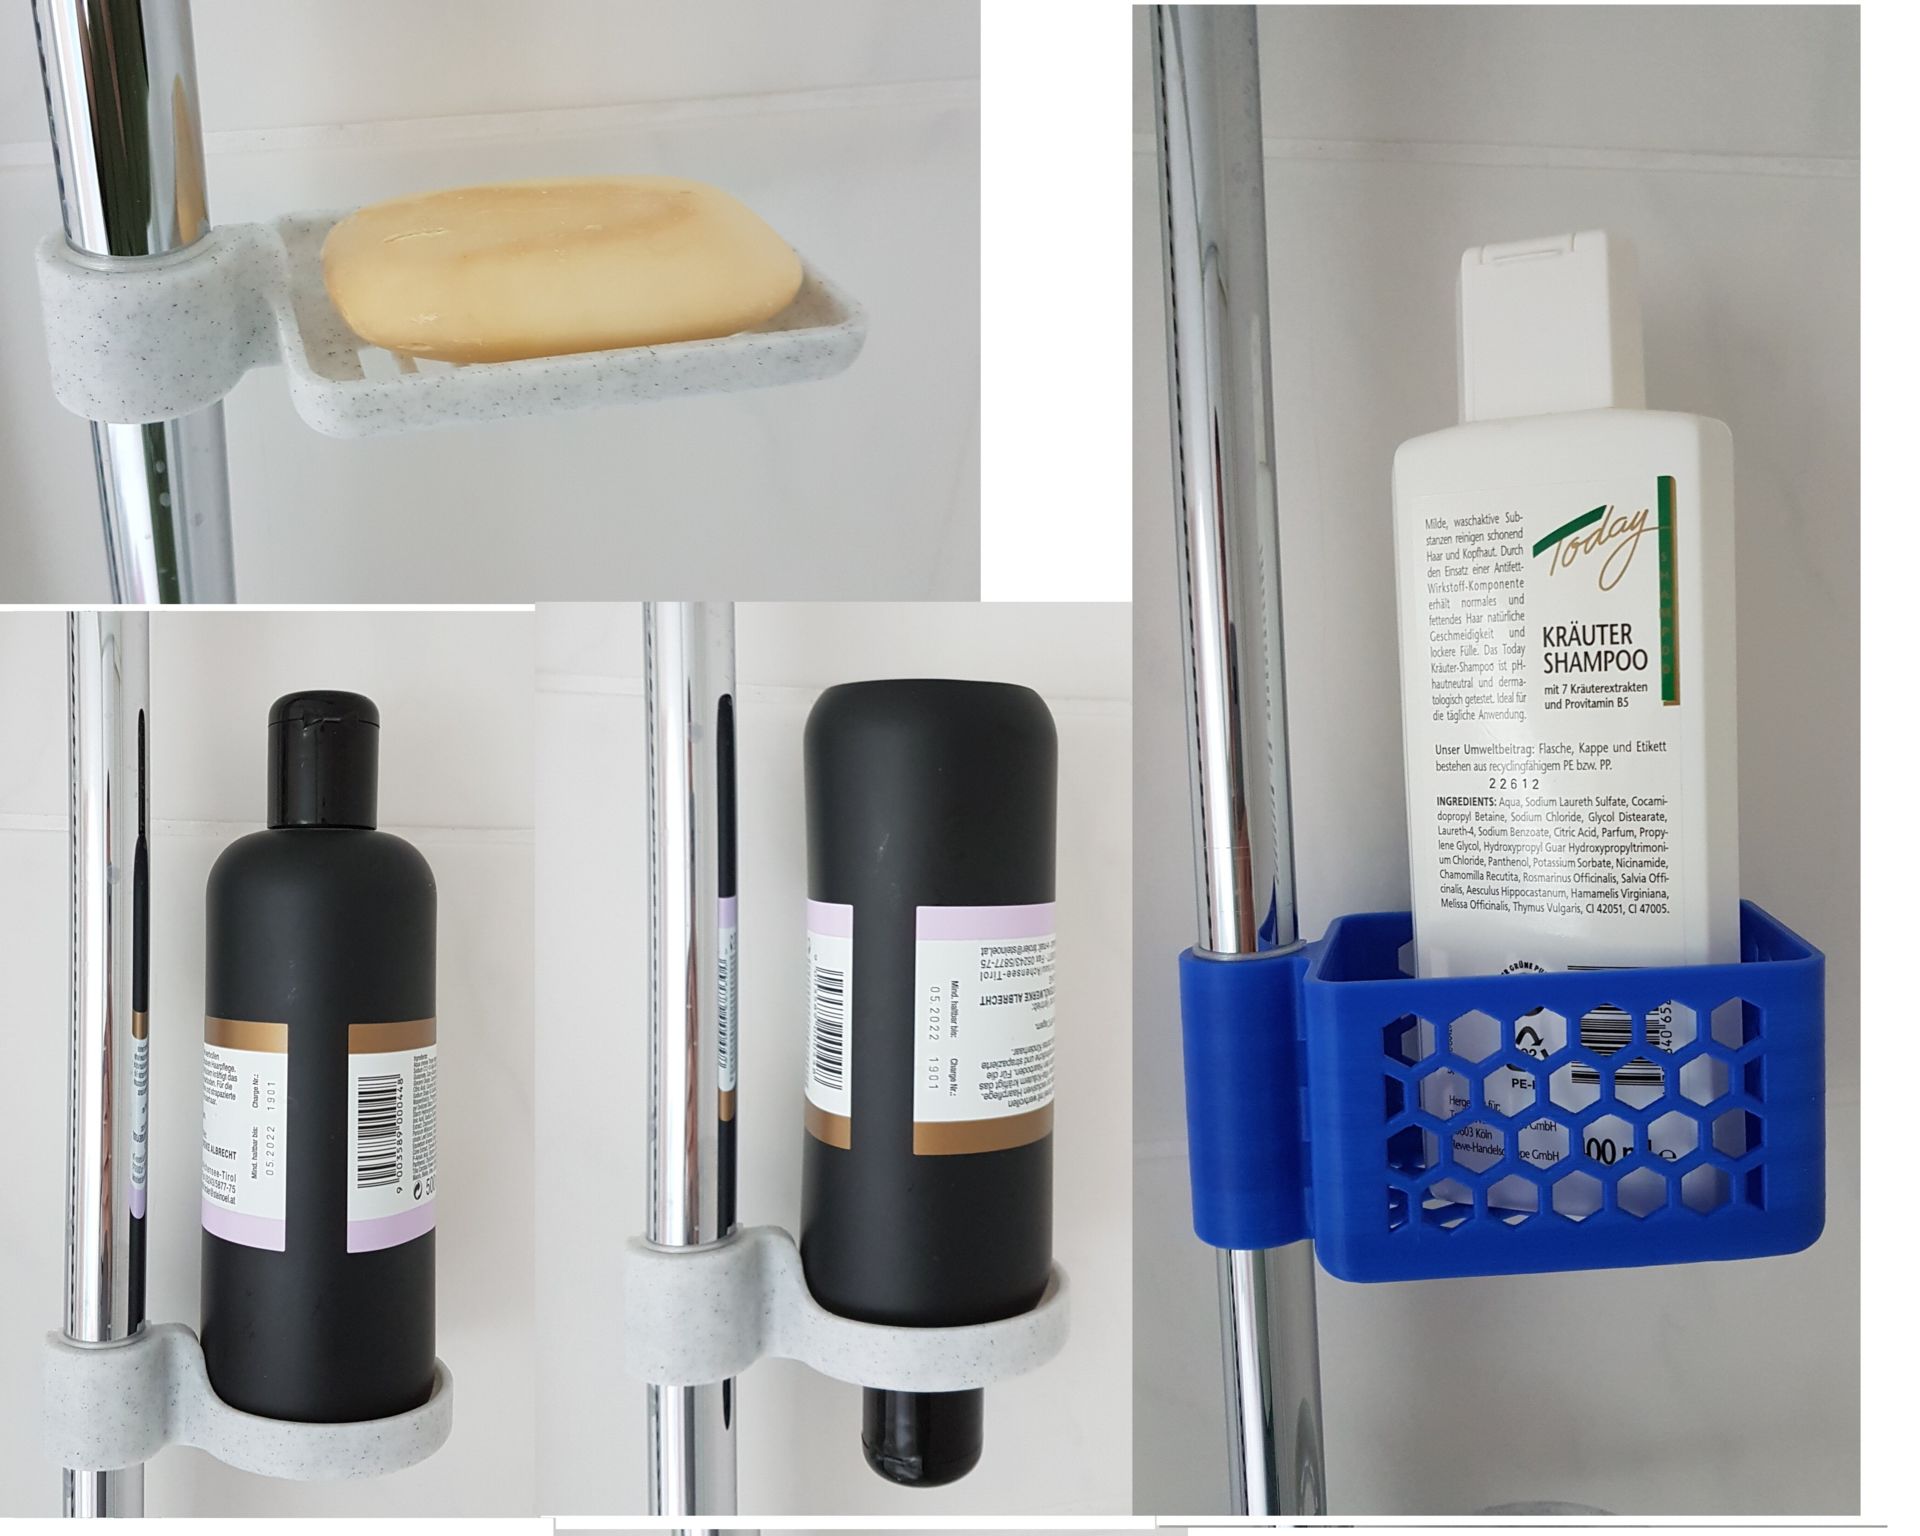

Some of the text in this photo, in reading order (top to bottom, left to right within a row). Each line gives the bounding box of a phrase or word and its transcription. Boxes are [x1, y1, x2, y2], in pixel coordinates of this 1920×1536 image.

[1425, 511, 1523, 530] Milde, waschaktive Sub-
[1426, 527, 1523, 546] stanzen reinigen schonend
[1426, 544, 1523, 562] Haar und Kopfhaut. Durch
[1533, 505, 1662, 591] Today
[1427, 561, 1524, 578] den Einsatz einer Antifett-
[1427, 578, 1524, 594] Wirkstoff-Komponente
[1429, 593, 1524, 610] erhält normales und
[1429, 610, 1525, 626] fettendes Haar natürliche
[1430, 626, 1525, 643] Geschmeidigkeit und
[1543, 620, 1633, 648] KRÄUTER
[1430, 643, 1526, 658] lockere Fülle. Das Today
[1431, 659, 1526, 675] Kräuter-Shampoo ist pH-
[1544, 649, 1648, 674] SHAMPOO
[1431, 676, 1526, 689] hautneutral und derma-
[1544, 681, 1648, 695] mit 7 Kräuterextrakten
[1432, 691, 1527, 708] tologisch getestet. Ideal für
[1544, 697, 1629, 710] und Provitamin B5
[1432, 708, 1527, 724] die tägliche Anwendung.
[1435, 740, 1667, 757] Unser Umweltbeitrag: Flasche, Kappe und Etikett
[1436, 759, 1612, 775] bestehen aus recyclingfähigem PE bzw. PP.
[1437, 795, 1668, 808] INGREDIENTS: Aqua, Sodium Laureth Sulfate, Cocami-
[1437, 811, 1667, 824] dopropyl Betaine, Sodium Chloride, Glycol Distearate,
[1438, 825, 1668, 840] Laureth-4, Sodium Benzoate, Citric Acid, Parfum, Propy-
[1438, 839, 1669, 855] lene Glycol, Hydroxypropyl Guar Hydroxypropyltrimoni-
[1439, 855, 1668, 869] um Chloride, Panthenol, Potassium Sorbate, Nicinamide,
[1440, 869, 1669, 885] Chamomilla Recutita, Rosmarinus Officinalis, Salvia Offi-
[1440, 884, 1669, 901] cinalis, Aesculus Hippocastanum, Hamamelis Virginiana,
[1441, 898, 1670, 916] Melissa Officinalis, Thymus Vulgaris, CI 42051, CI 47005.
[1509, 960, 1533, 971] GRÜNE
[979, 992, 1023, 1006] ALBRECHT
[928, 986, 940, 1089] 05.2022 1901
[228, 1074, 238, 1082] das
[986, 1071, 999, 1080] die
[1000, 1070, 1012, 1079] Für
[979, 1082, 994, 1090] das
[265, 1082, 276, 1176] 05.2022 1901
[1475, 1128, 1492, 1140] Köln
[210, 1143, 237, 1160] ALBRECHT
[1532, 1149, 1560, 1161] GmbH
[396, 1186, 403, 1194] 9
